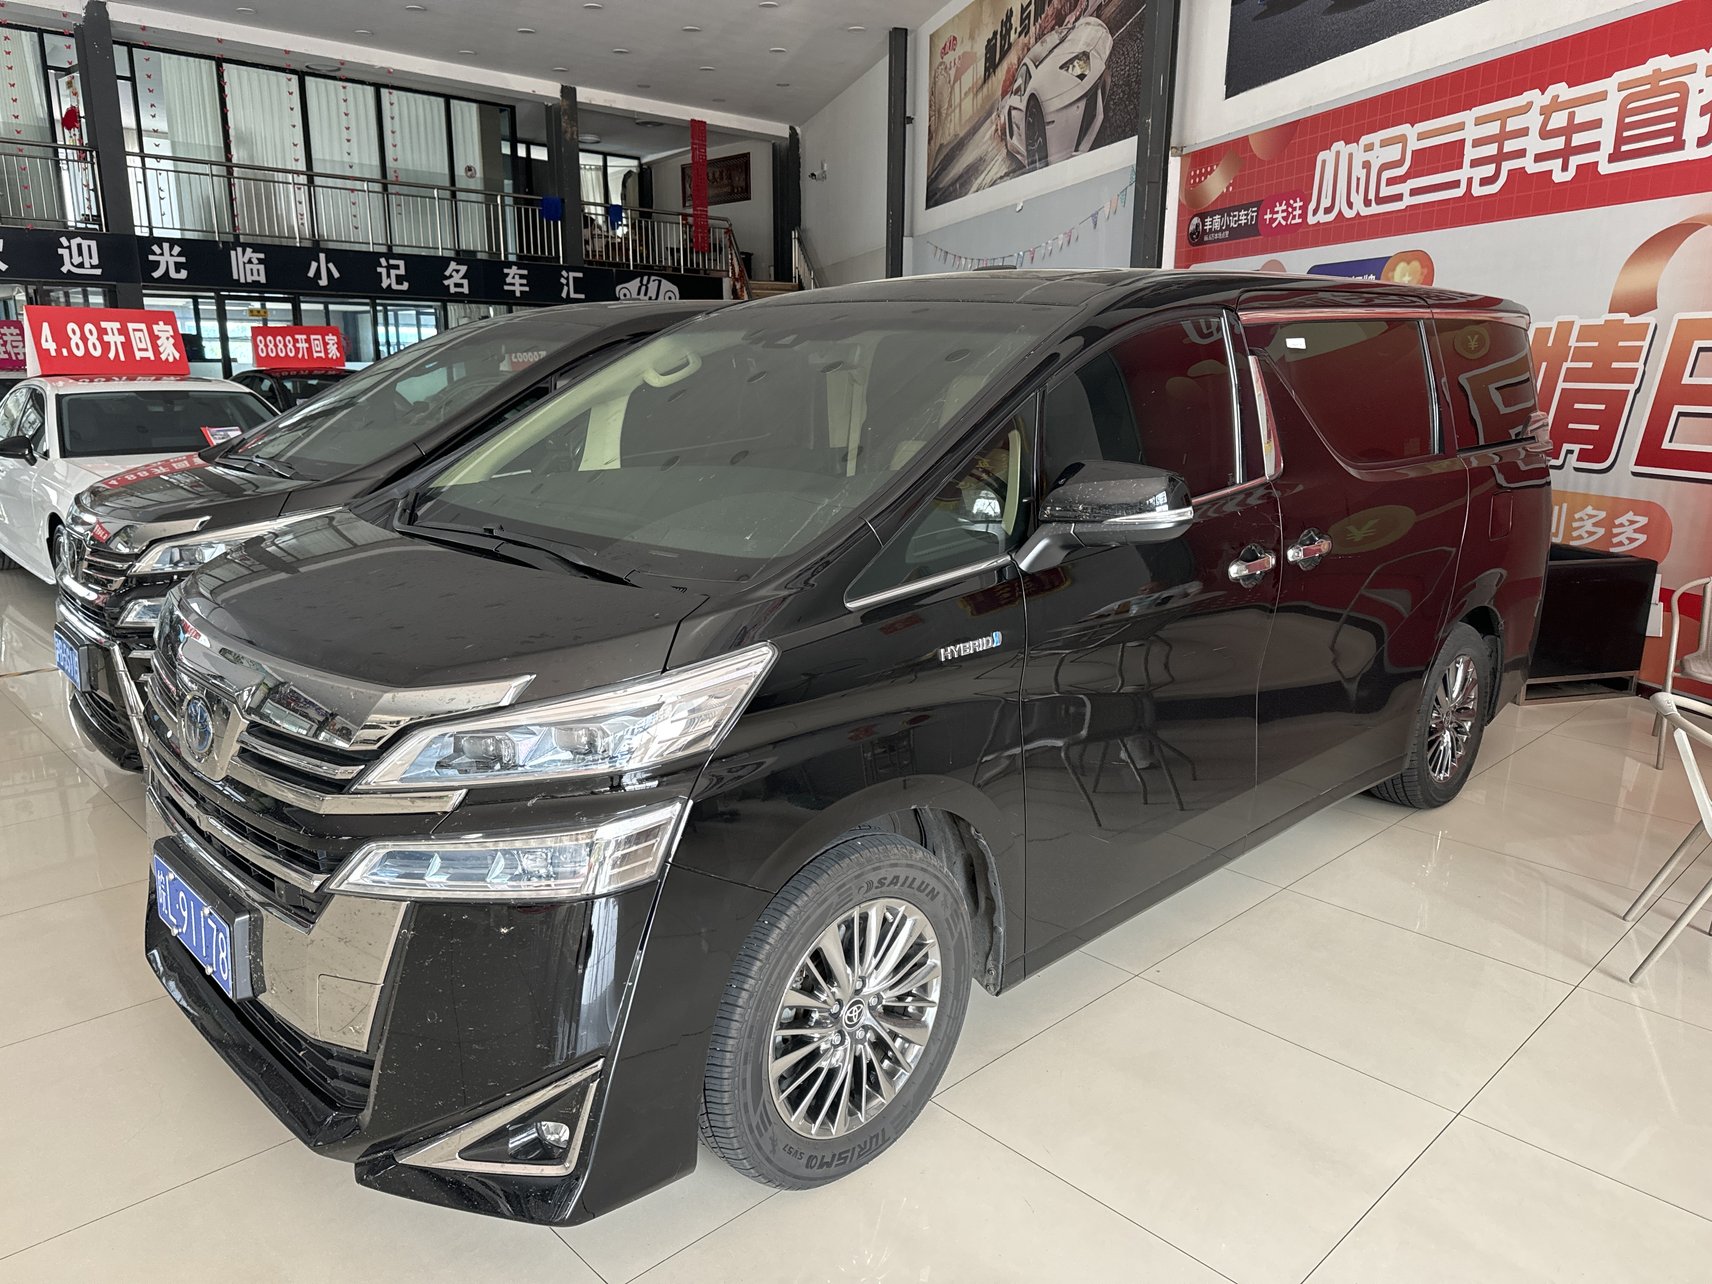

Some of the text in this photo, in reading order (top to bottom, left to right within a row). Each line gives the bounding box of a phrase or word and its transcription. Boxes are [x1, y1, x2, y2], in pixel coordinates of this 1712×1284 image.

[1308, 50, 1712, 224] 小记二手车直
[1204, 207, 1258, 233] 丰南小记车行
[1264, 197, 1304, 228] +关注
[0, 236, 586, 300] 迎光临小记名车汇
[40, 321, 181, 362] 4.88开回家
[256, 333, 341, 360] 8888开回家
[940, 636, 993, 662] HYBRID
[874, 874, 940, 901] SAILUN
